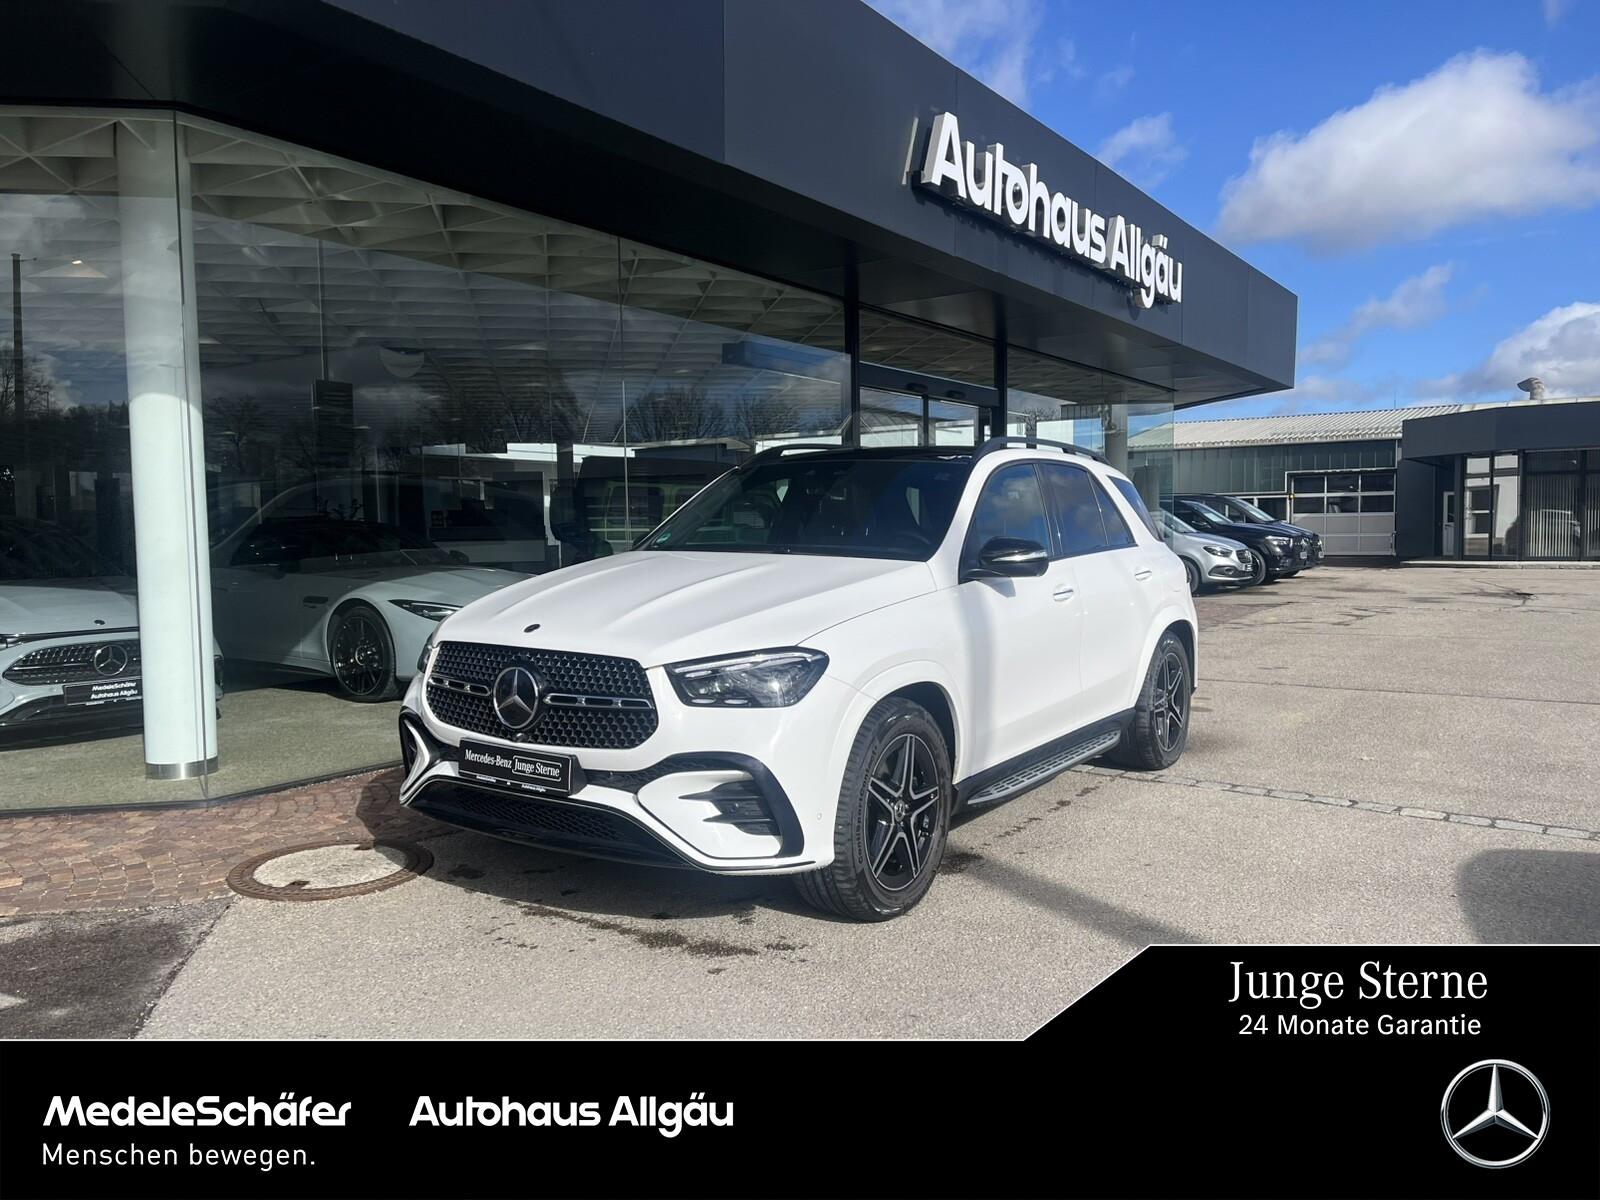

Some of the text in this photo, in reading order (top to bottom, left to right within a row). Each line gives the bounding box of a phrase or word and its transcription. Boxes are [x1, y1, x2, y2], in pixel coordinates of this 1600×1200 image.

[921, 111, 1183, 309] Autohaus Allgäu
[465, 749, 560, 777] Mercedes-Benz Junge Sterne
